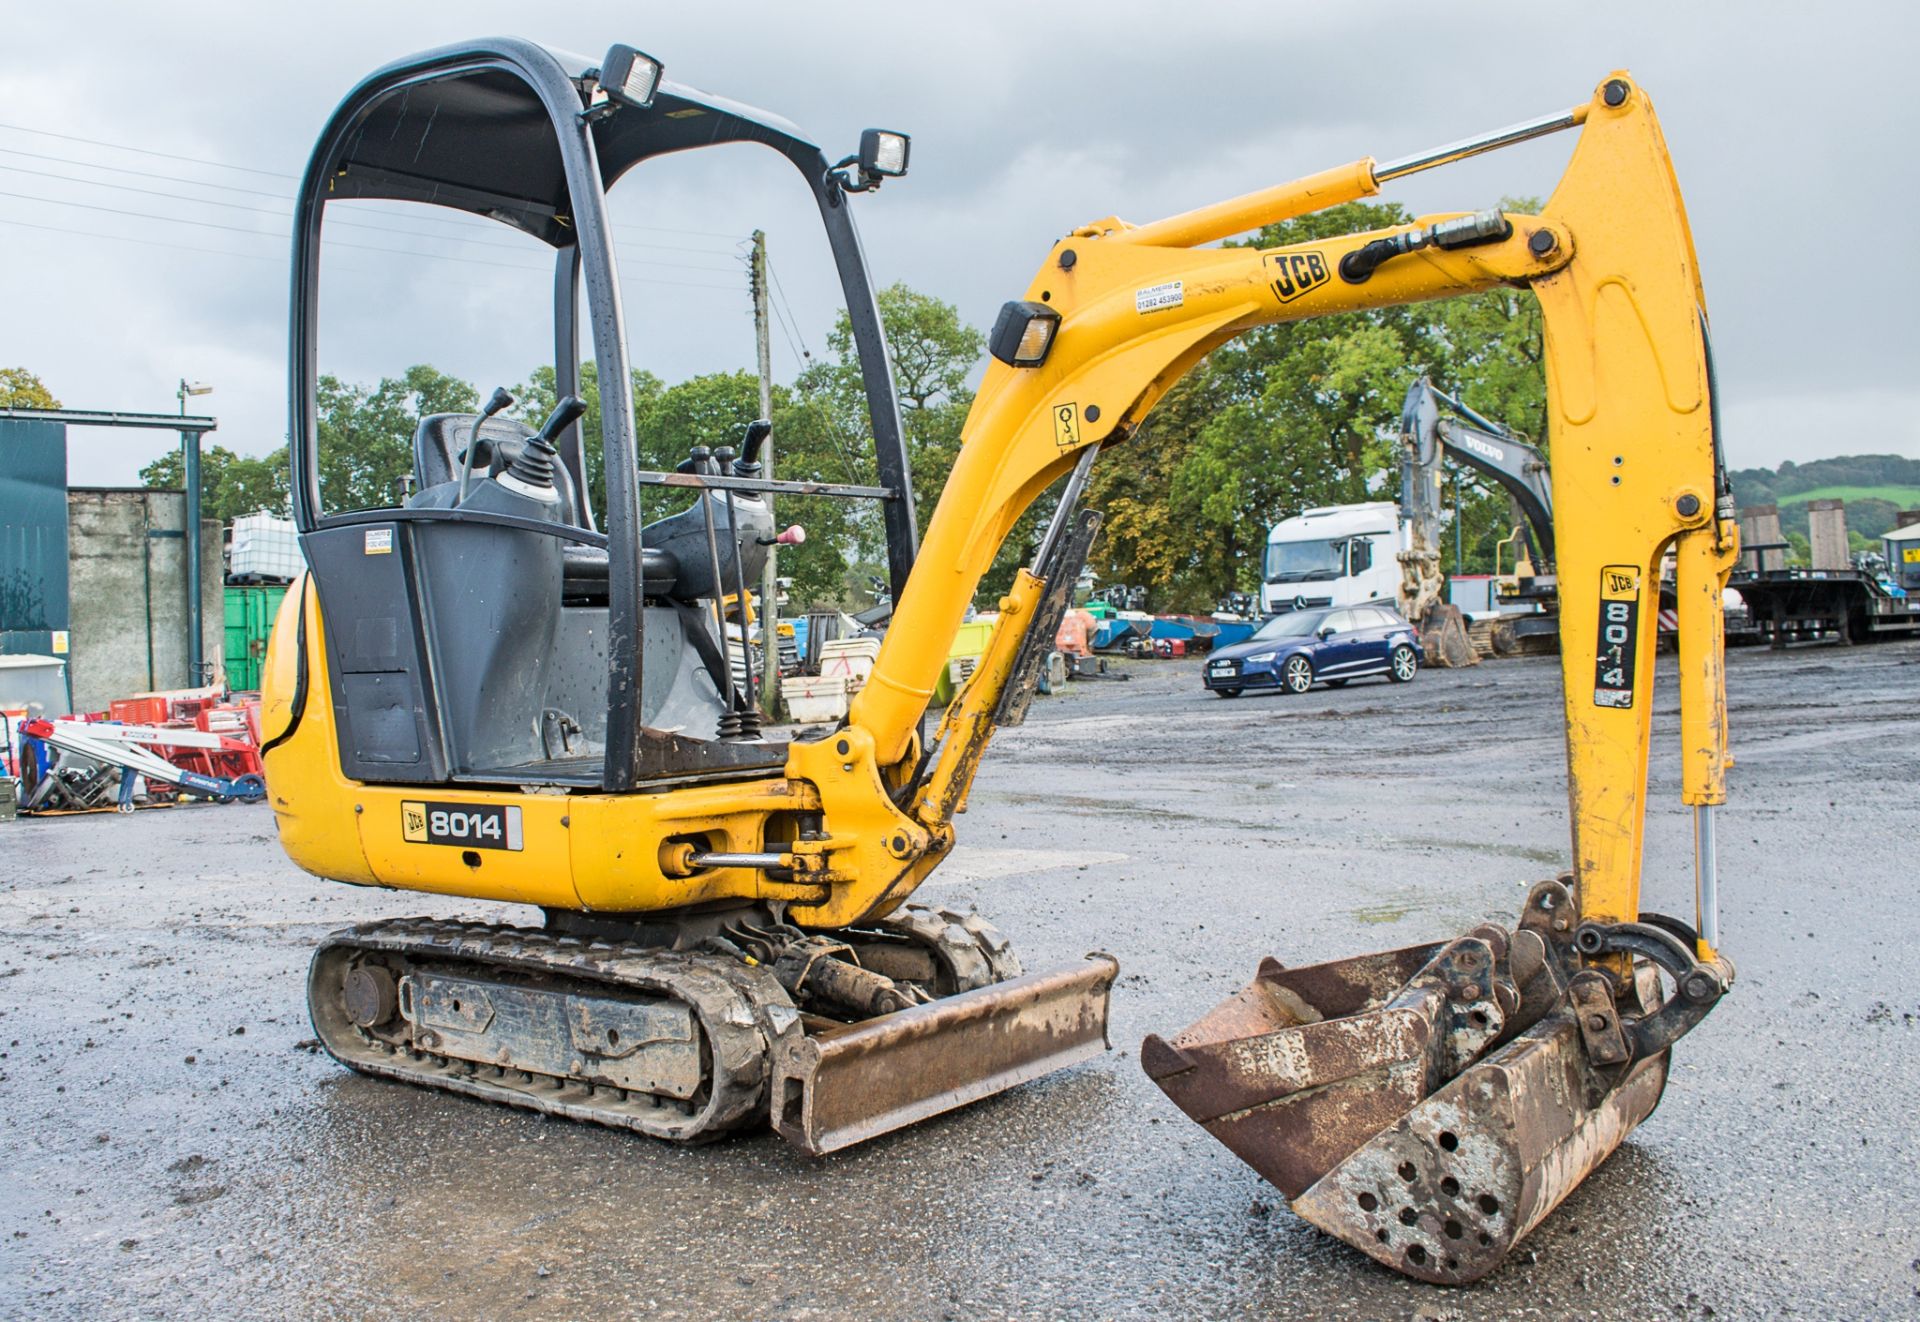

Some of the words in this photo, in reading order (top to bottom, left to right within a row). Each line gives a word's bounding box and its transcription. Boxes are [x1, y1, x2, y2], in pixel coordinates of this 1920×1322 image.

[1275, 255, 1325, 297] JCB
[1464, 434, 1504, 461] VOLVO
[1610, 574, 1632, 593] JCB
[1603, 603, 1629, 687] 8014
[407, 812, 424, 831] JCB
[430, 811, 502, 840] 8014
